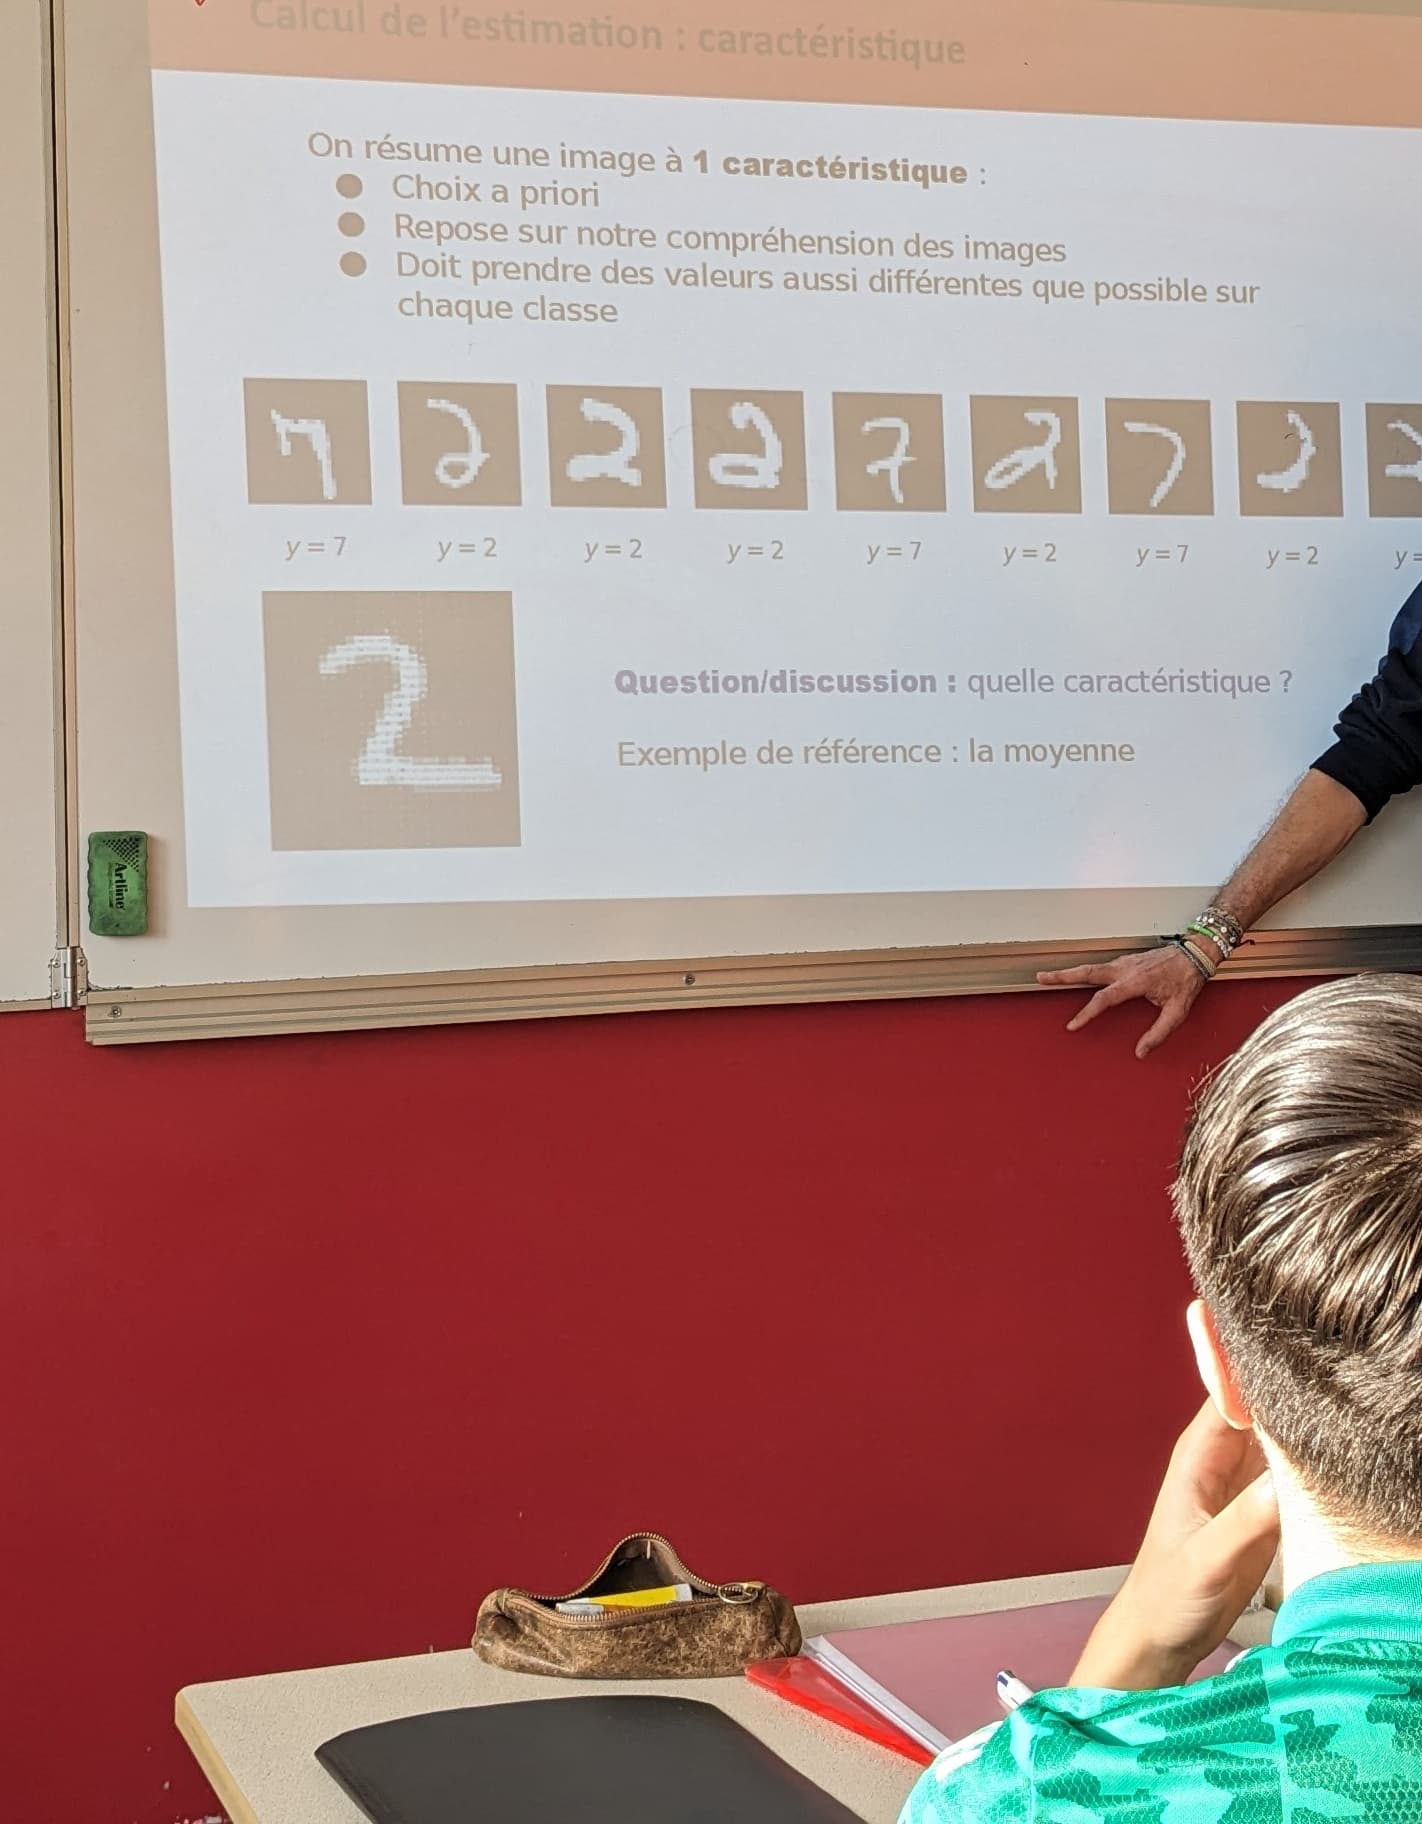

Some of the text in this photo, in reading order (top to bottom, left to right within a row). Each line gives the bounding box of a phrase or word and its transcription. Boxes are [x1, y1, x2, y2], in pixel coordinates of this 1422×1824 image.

[251, 0, 367, 33] Calcul
[380, 3, 427, 38] de
[699, 23, 965, 69] caractéristique
[308, 132, 352, 158] On
[365, 134, 482, 163] résume
[493, 146, 549, 167] une
[560, 142, 655, 177] image
[666, 146, 682, 172] à
[694, 150, 707, 173] 1
[723, 156, 967, 189] caractéristique
[393, 174, 599, 210] Choix a priori
[395, 214, 1066, 267] Repose sur notre compréhension des images
[397, 252, 1260, 306] Doit prendre des valeurs aussi différentes que possible sur
[398, 291, 618, 325] chaque classe
[615, 669, 936, 695] Question/discussion
[968, 668, 1054, 699] quelle
[1064, 667, 1270, 699] caractéristique
[319, 635, 502, 790] 2
[619, 740, 746, 772] Exemple
[757, 740, 793, 764] de
[804, 738, 941, 764] référence
[970, 738, 993, 762] la
[1005, 743, 1135, 768] moyenne
